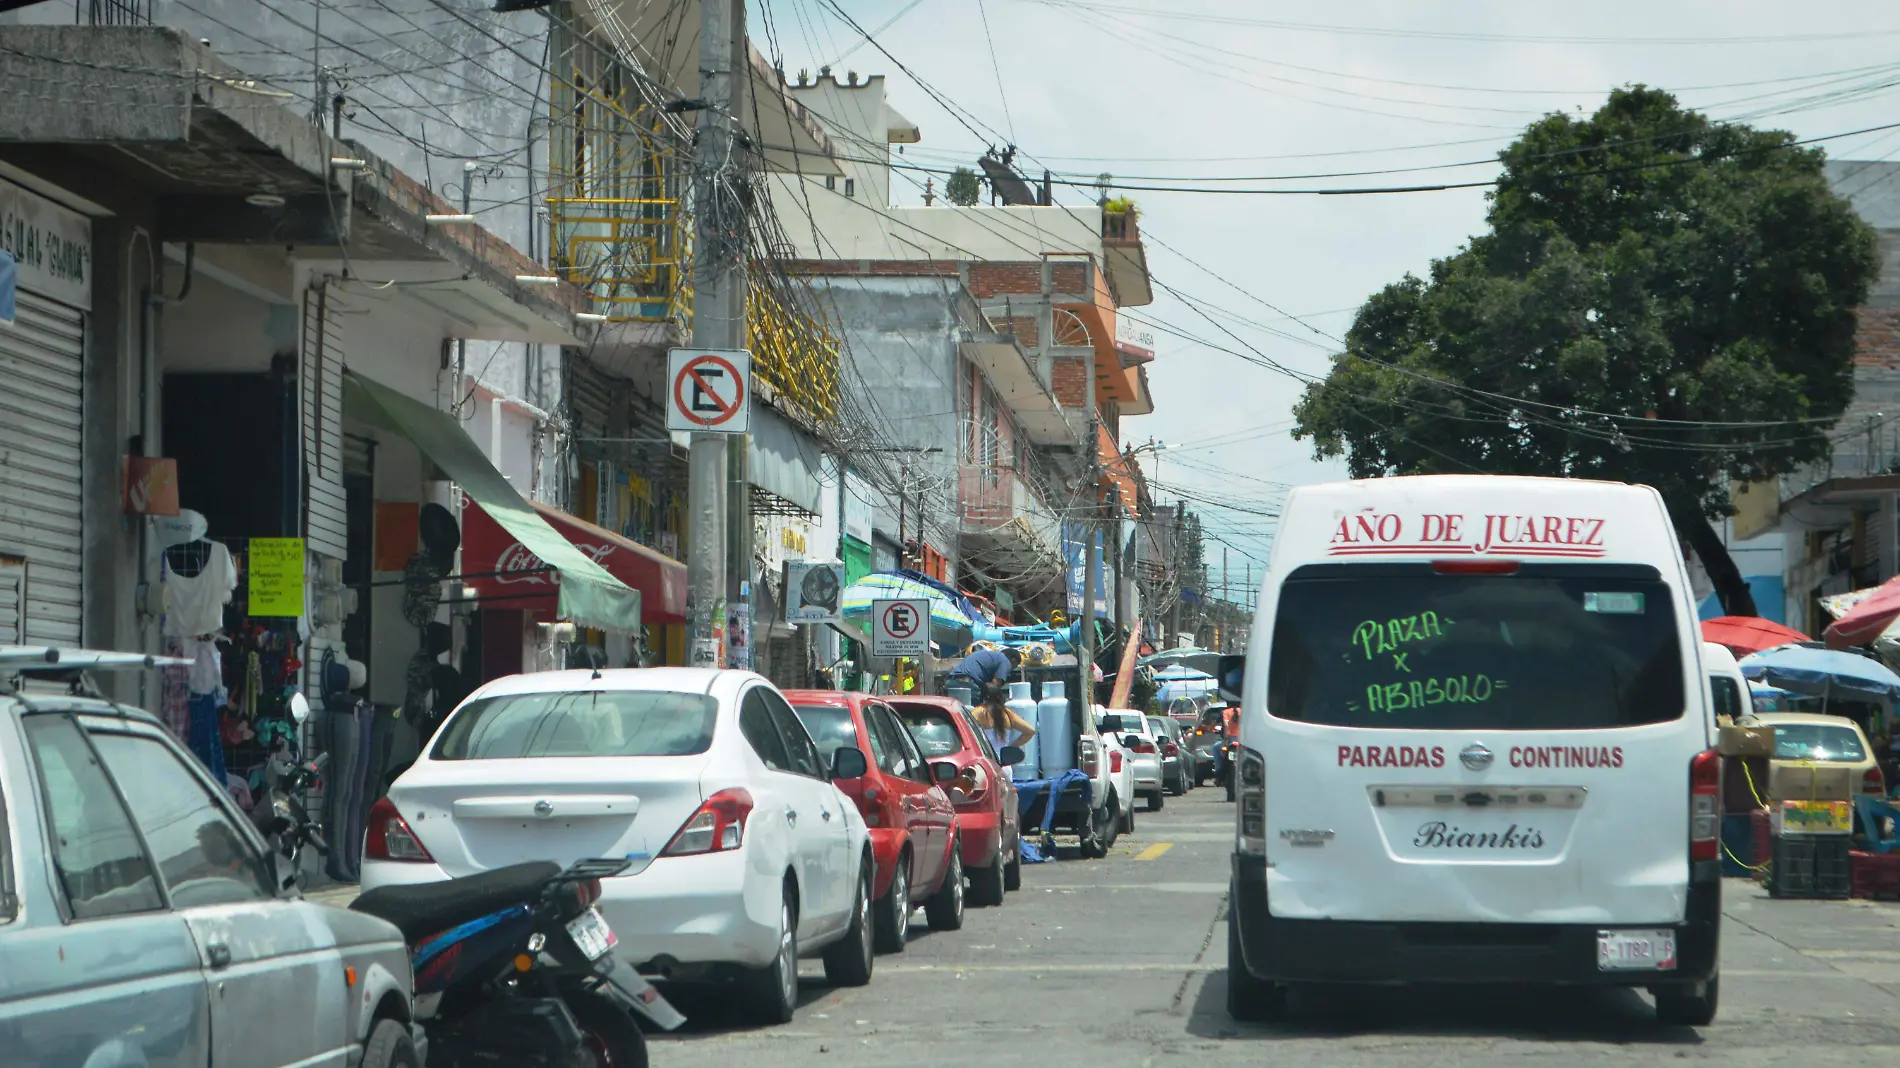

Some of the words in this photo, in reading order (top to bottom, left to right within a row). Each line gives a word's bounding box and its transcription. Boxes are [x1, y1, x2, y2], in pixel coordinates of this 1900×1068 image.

[1330, 507, 1402, 543] AÑO
[1420, 514, 1464, 542] DE
[1474, 514, 1607, 551] JUAREZ
[1353, 610, 1443, 660] PLAZA
[1338, 745, 1445, 768] PARADAS
[1509, 745, 1624, 769] CONTINUAS
[1413, 820, 1544, 849] Biankis
